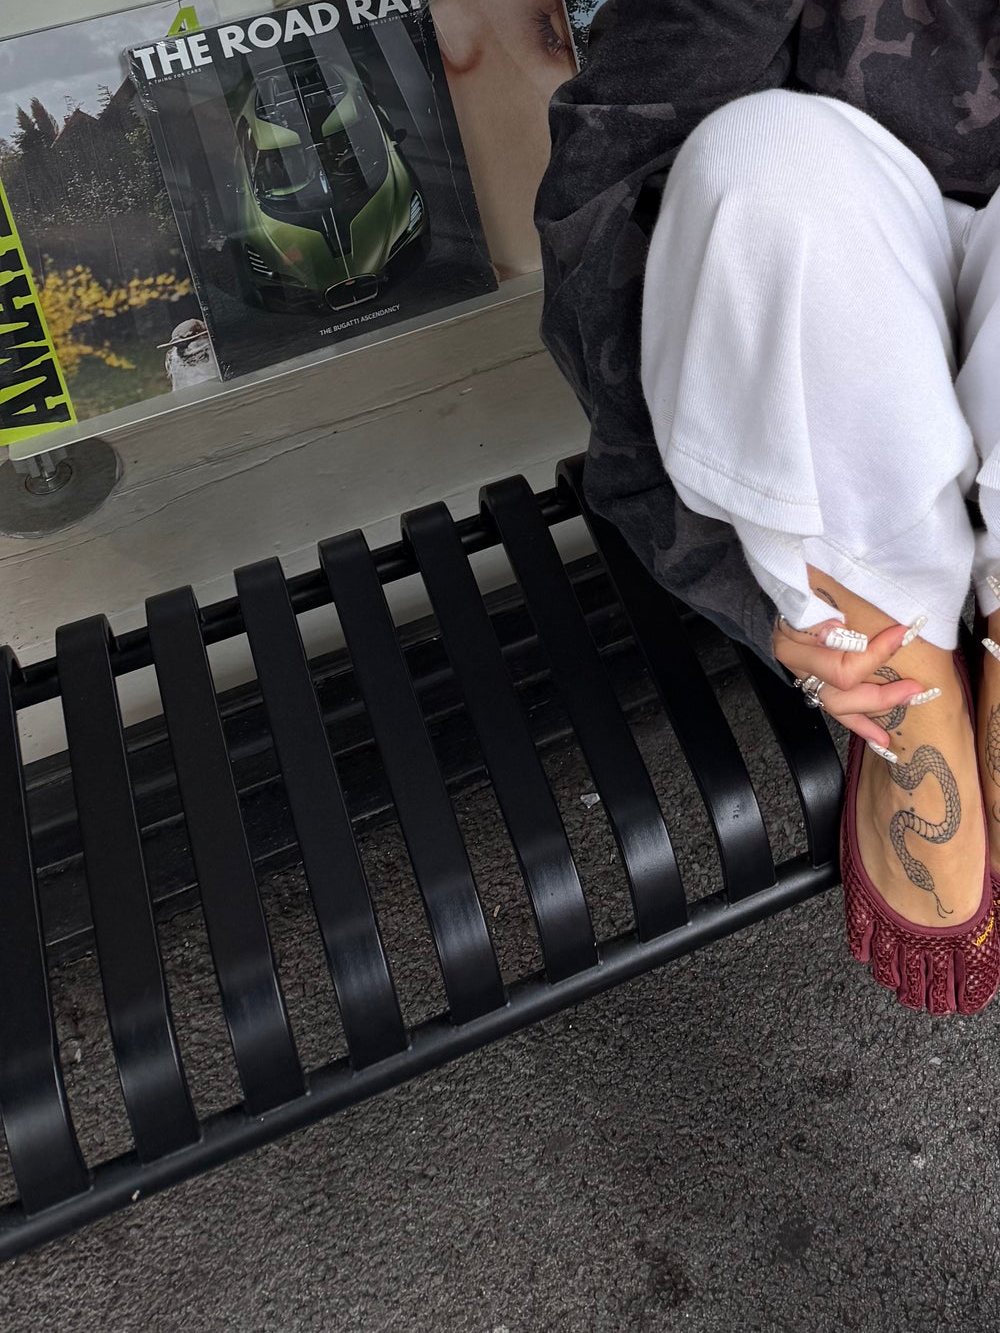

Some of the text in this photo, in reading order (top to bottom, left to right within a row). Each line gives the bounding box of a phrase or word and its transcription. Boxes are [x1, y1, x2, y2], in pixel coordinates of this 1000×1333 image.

[131, 32, 213, 81] THE
[217, 1, 341, 60] ROAD
[319, 303, 400, 336] THE BUGATTI ASCENDANCY
